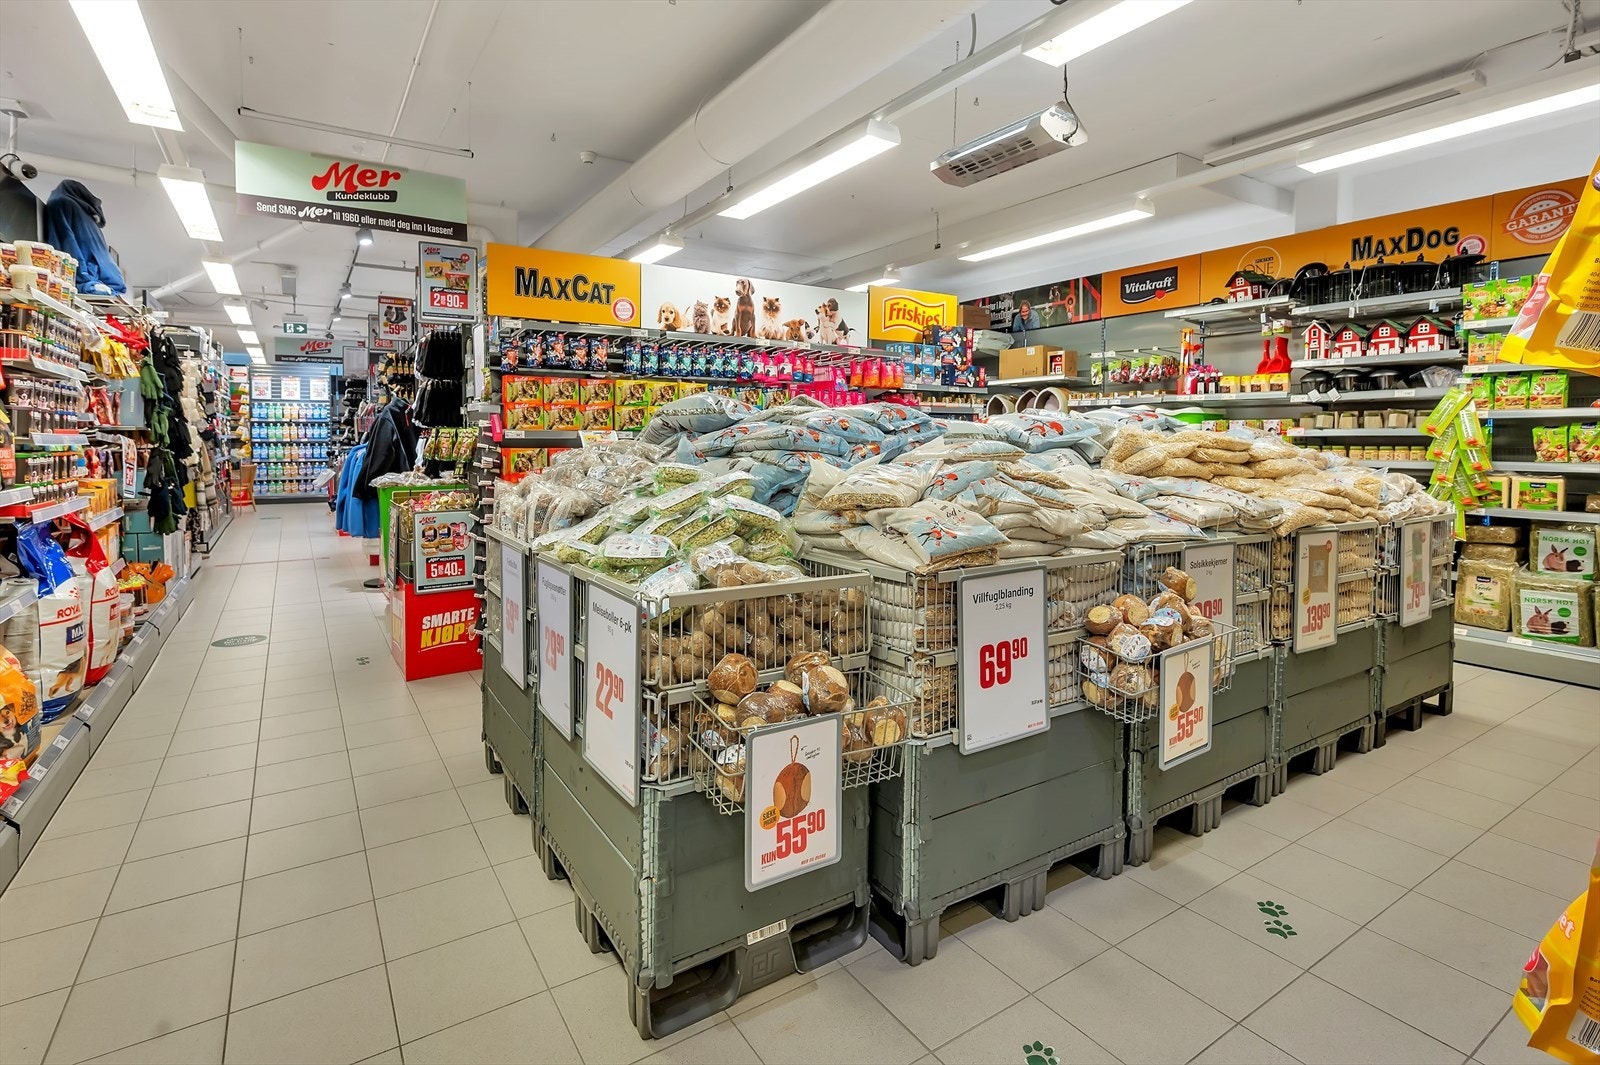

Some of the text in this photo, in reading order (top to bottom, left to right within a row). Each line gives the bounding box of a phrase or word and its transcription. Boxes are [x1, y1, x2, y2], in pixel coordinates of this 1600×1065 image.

[312, 161, 402, 193] Mer
[335, 191, 390, 201] Kundeklubb
[256, 201, 278, 213] Send
[278, 204, 297, 216] SMS
[298, 206, 333, 218] Mer
[333, 211, 341, 220] til
[341, 212, 360, 224] 1960
[361, 215, 377, 225] eller
[378, 217, 396, 228] meld
[397, 219, 411, 231] deg
[411, 222, 422, 232] inn
[427, 223, 454, 236] kassen!
[1506, 201, 1578, 231] GARANT
[1124, 276, 1173, 294] Vitakraft
[433, 293, 440, 306] 2
[888, 301, 941, 327] Friskies
[300, 340, 333, 352] Mer
[1542, 535, 1570, 544] NORSK
[430, 563, 438, 578] 5
[973, 586, 1034, 604] Villfuglblanding
[1524, 597, 1553, 605] NORSK
[995, 603, 1006, 611] 2,25
[422, 607, 475, 630] SMARTE
[592, 601, 632, 634] Meiseboller 6-pk
[421, 622, 465, 649] KJØP
[761, 850, 777, 865] KUN
